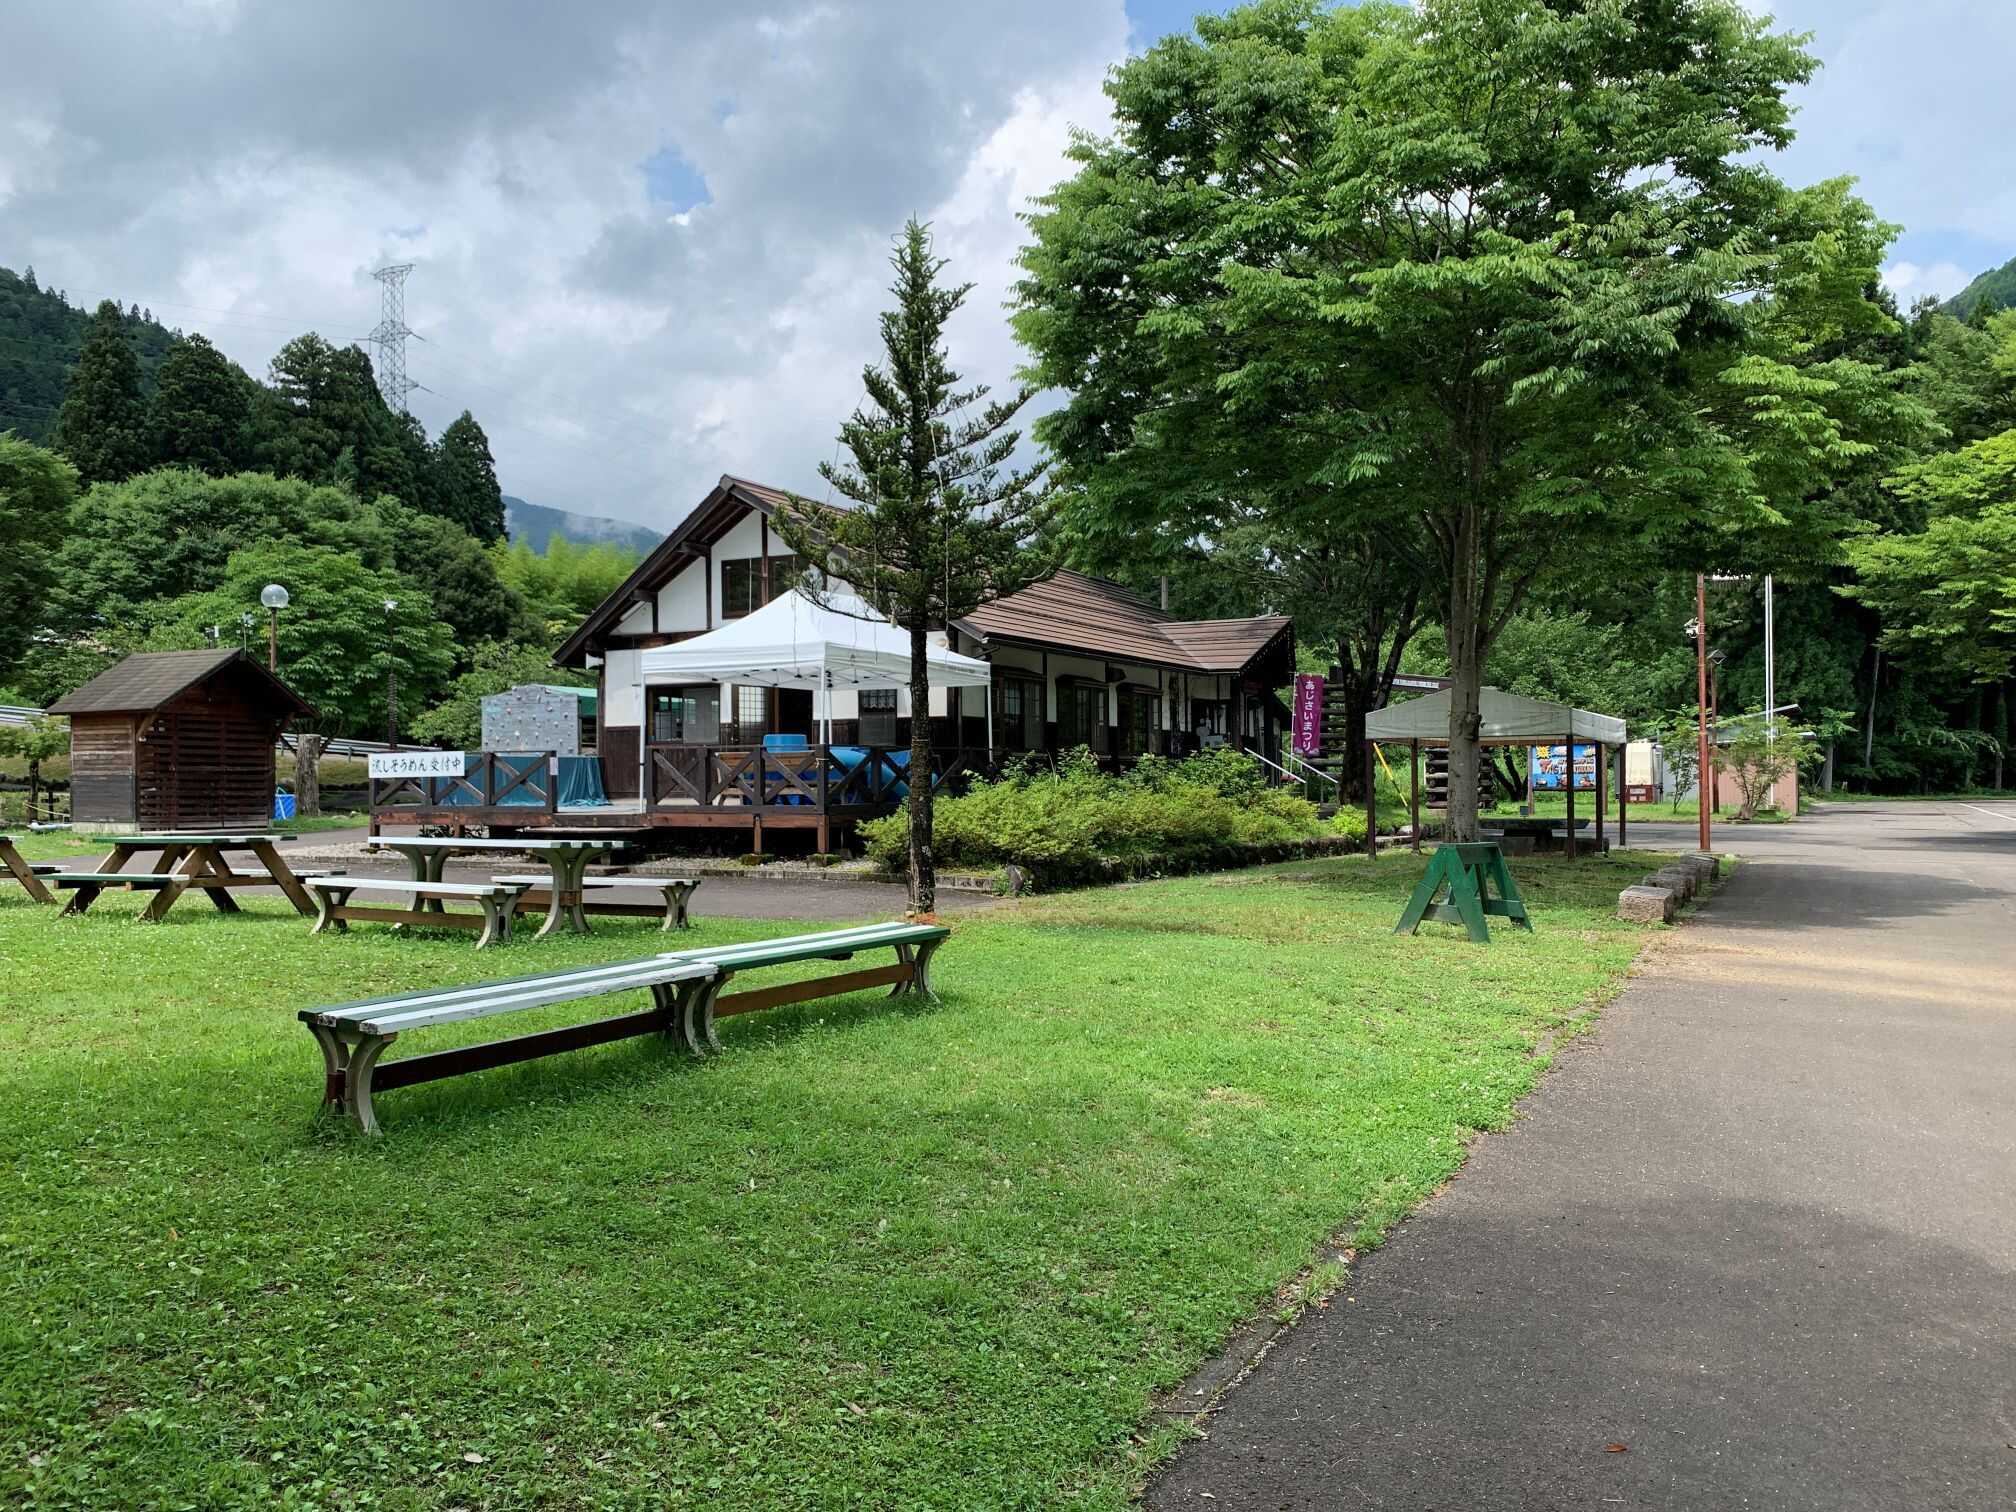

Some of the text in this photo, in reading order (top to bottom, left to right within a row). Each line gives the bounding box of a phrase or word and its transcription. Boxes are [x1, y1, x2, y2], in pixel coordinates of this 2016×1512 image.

[1301, 680, 1315, 751] あじさいまつり
